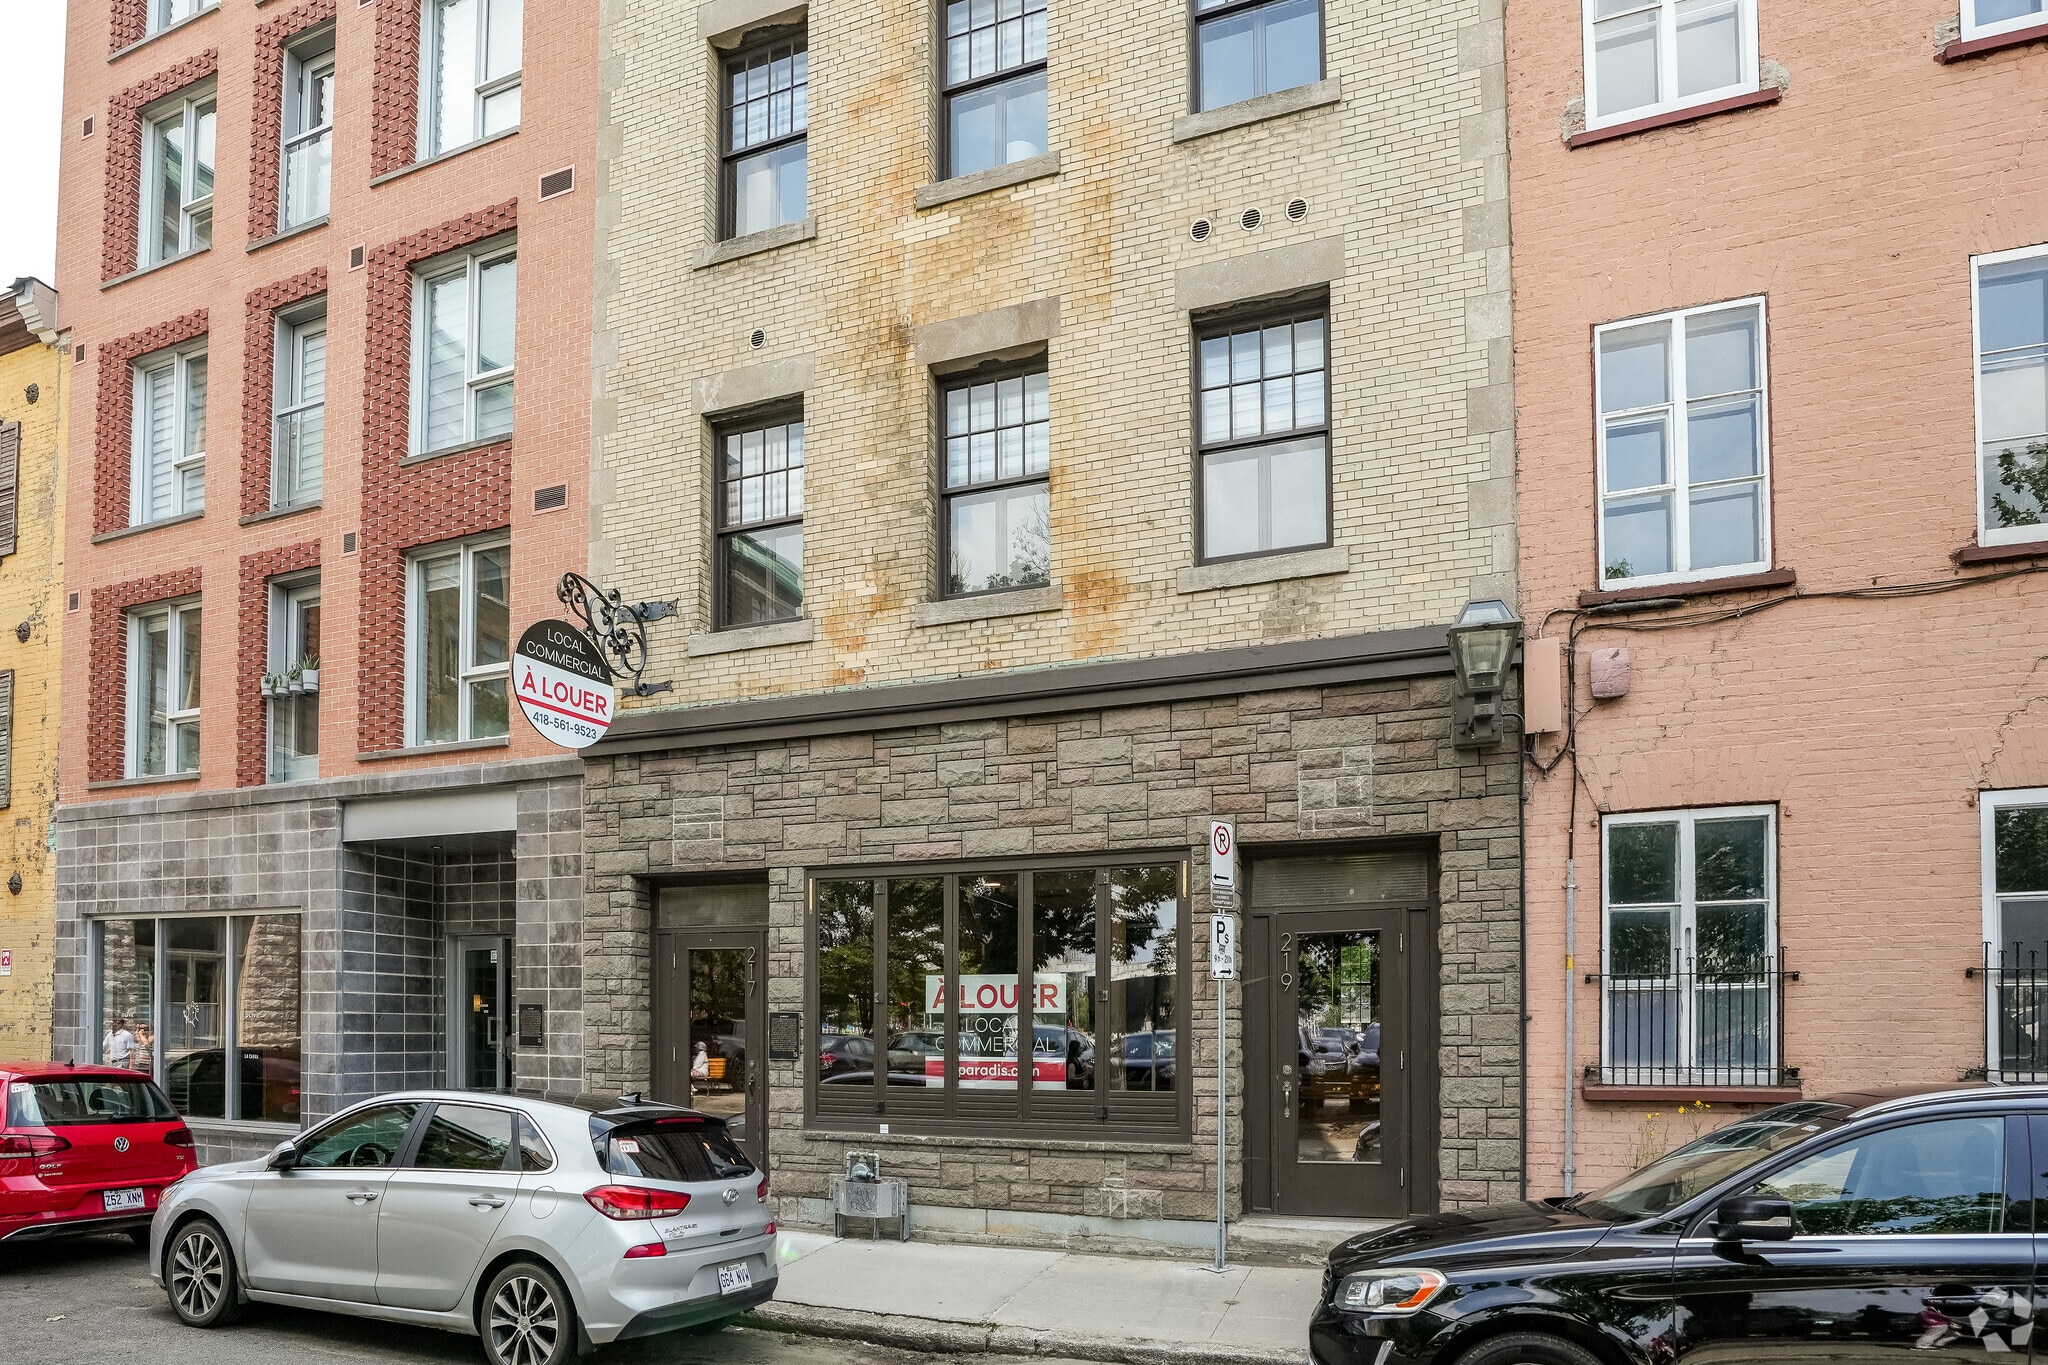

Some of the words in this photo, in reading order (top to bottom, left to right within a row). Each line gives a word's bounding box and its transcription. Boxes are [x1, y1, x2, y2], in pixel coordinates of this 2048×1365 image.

[547, 628, 586, 655] LOCAL
[526, 640, 605, 680] COMMERCIAL
[522, 664, 537, 694] À
[542, 676, 607, 716] LOUER
[532, 711, 597, 740] 418-561-9523
[747, 946, 756, 997] 217
[1280, 932, 1293, 992] 219
[965, 1017, 1015, 1033] LOCA
[126, 1191, 143, 1204] XNM
[720, 1272, 734, 1288] G64
